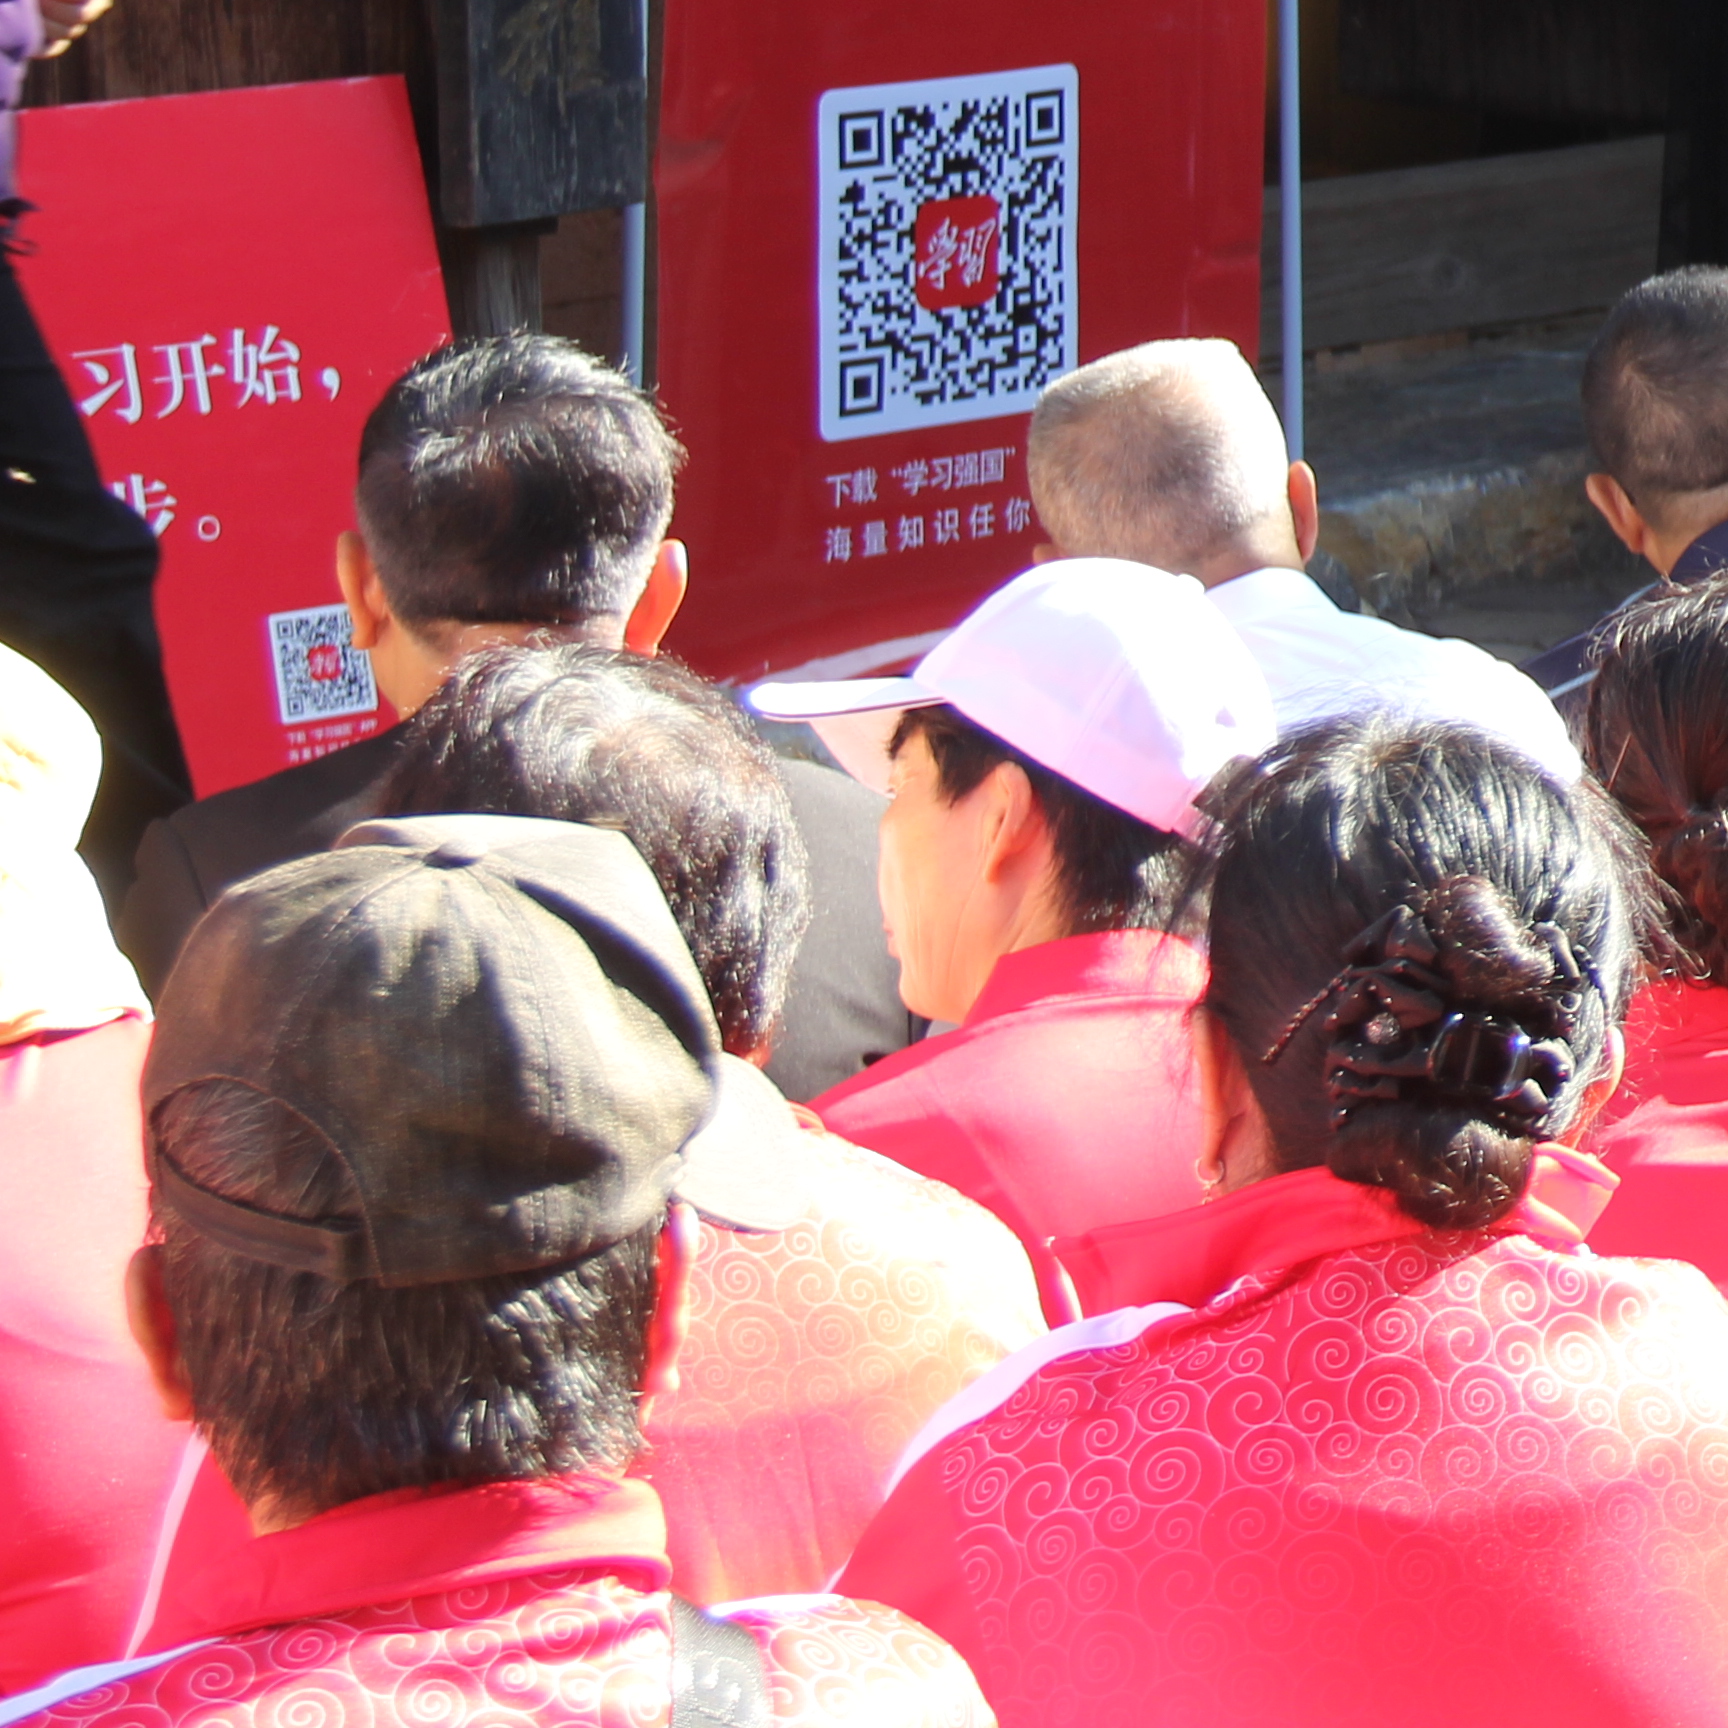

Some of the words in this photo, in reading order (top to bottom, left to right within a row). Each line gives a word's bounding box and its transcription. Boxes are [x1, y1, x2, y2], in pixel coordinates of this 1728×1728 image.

[826, 468, 877, 509] 下载
[826, 496, 1030, 563] 海量知识任你
